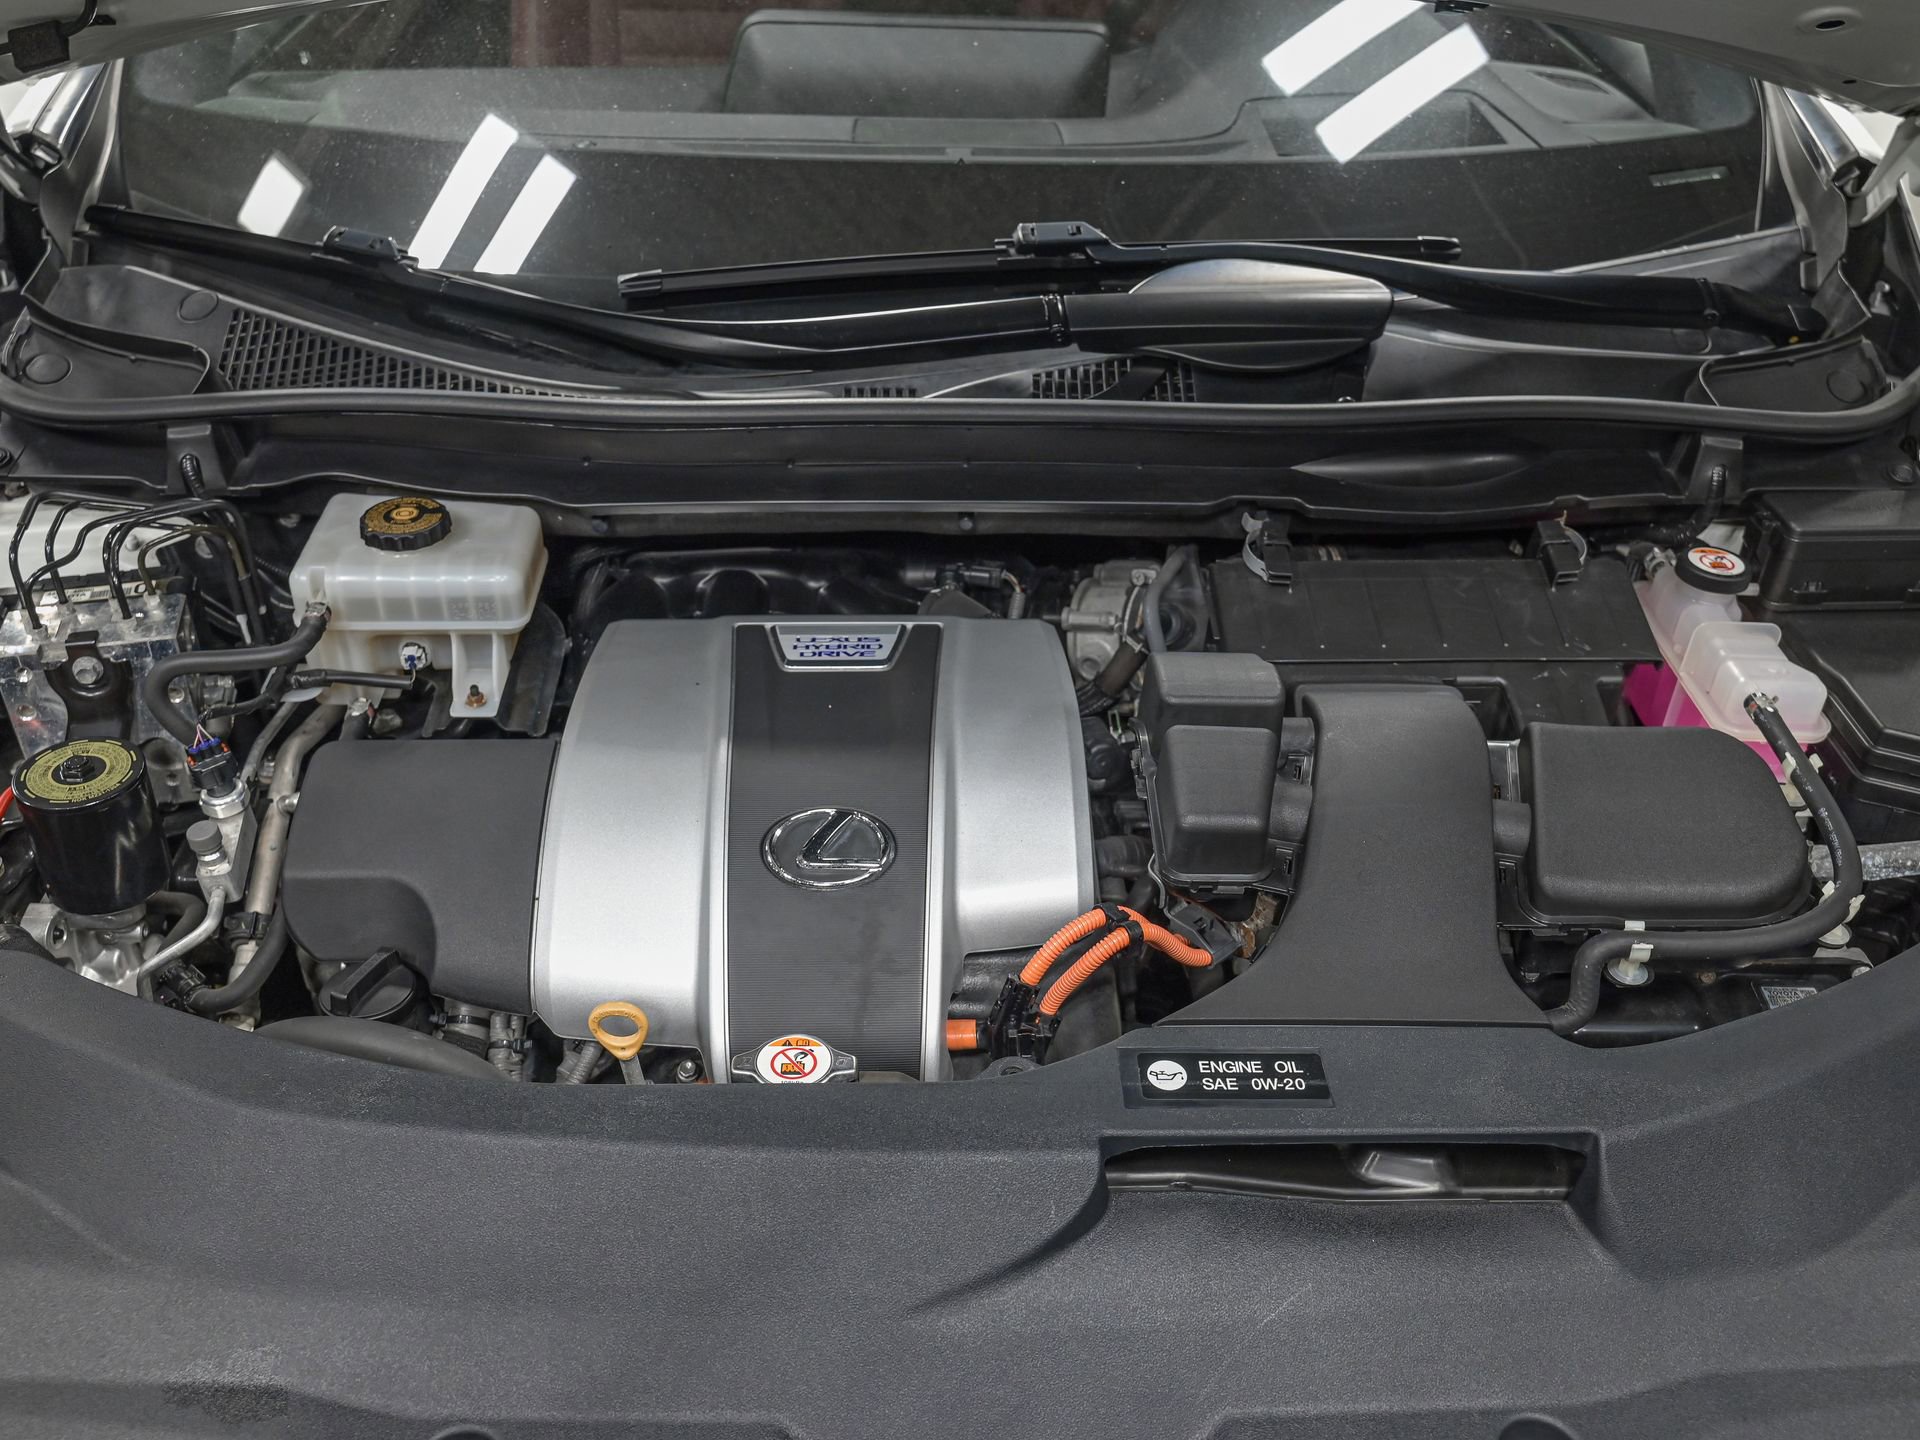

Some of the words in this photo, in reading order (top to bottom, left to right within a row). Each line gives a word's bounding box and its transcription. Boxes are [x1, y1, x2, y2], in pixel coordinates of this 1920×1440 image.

[1198, 1060, 1264, 1073] ENGINE
[1274, 1060, 1304, 1073] OIL
[1202, 1077, 1239, 1090] SAE
[1251, 1077, 1306, 1090] 0W-20
